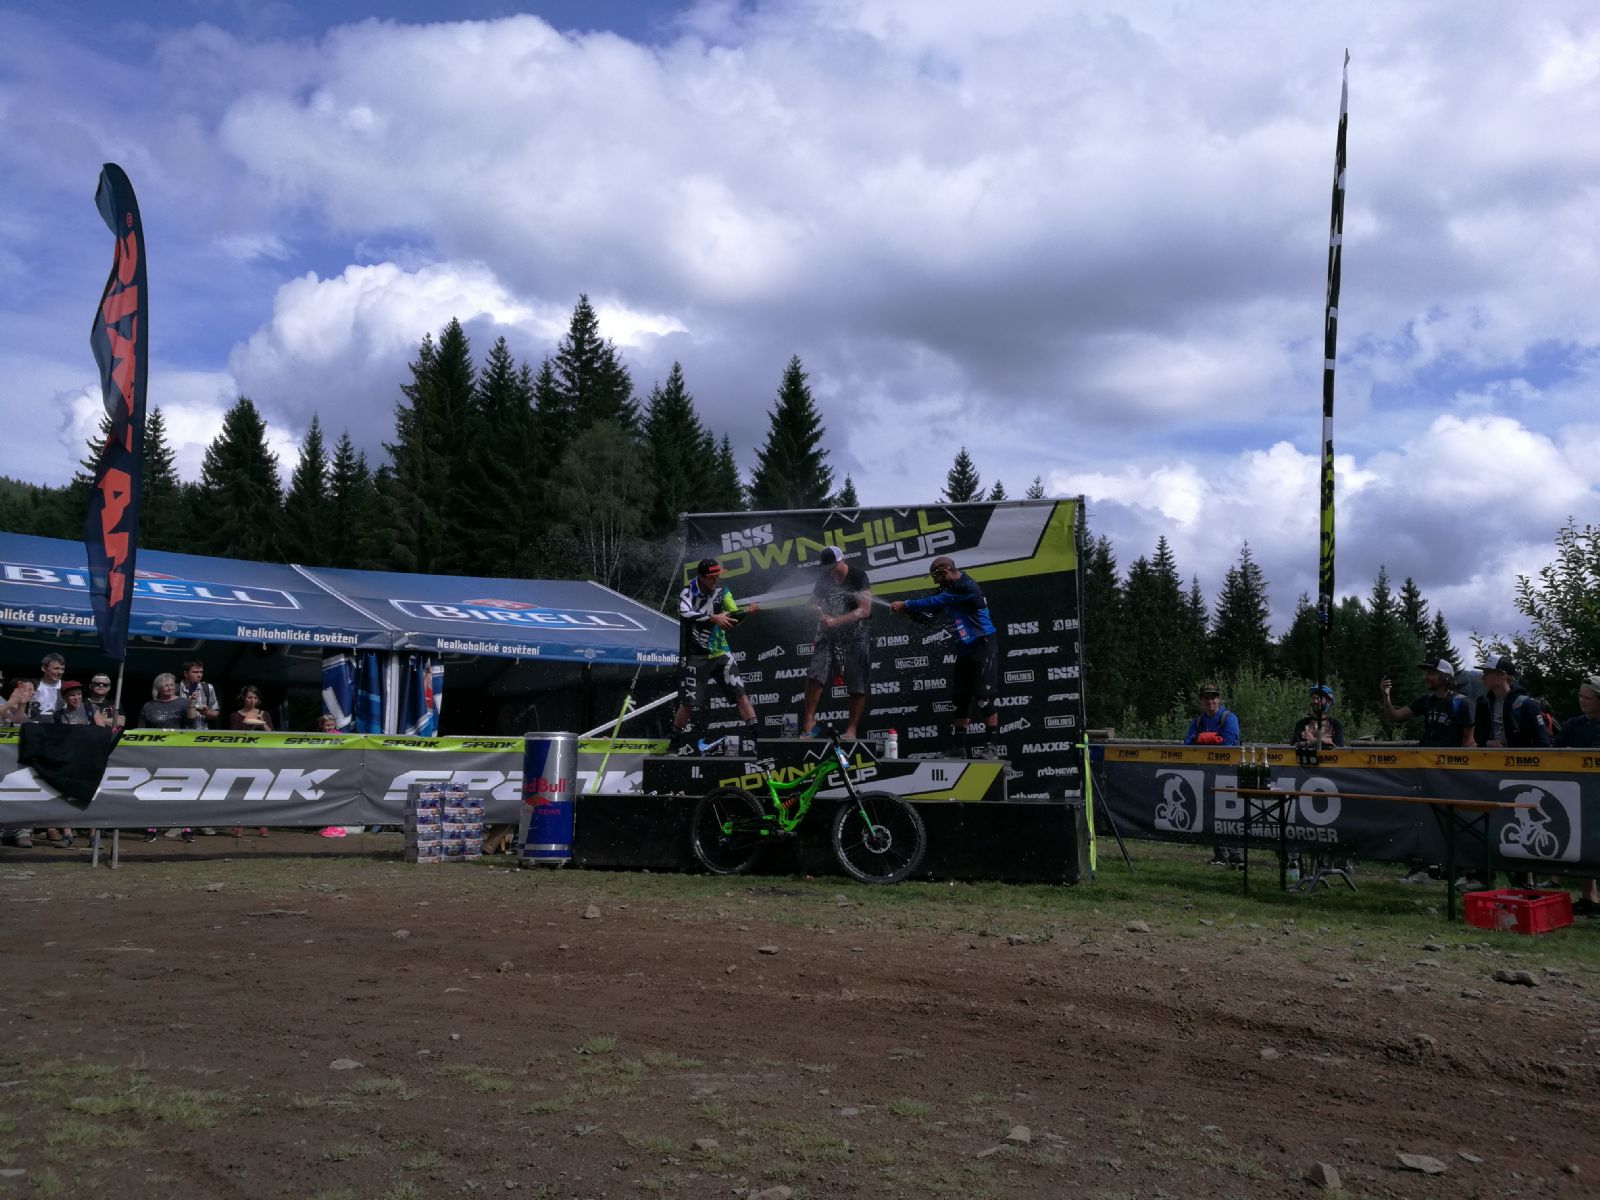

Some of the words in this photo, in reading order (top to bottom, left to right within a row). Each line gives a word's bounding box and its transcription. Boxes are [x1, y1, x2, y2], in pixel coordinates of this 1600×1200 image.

[866, 529, 956, 567] CUP
[4, 565, 276, 605] BIELL
[39, 612, 96, 626] osvěžení
[420, 602, 626, 628] BIRELL
[237, 626, 310, 641] Nealkoholické
[313, 633, 358, 645] osvěžení
[437, 639, 499, 653] Nealkoholické
[502, 643, 540, 656] osvěžení
[637, 652, 680, 664] Nealkoholic
[775, 667, 807, 680] MAXX
[685, 665, 697, 699] FOX
[993, 695, 1030, 707] AXXIS
[1021, 741, 1070, 754] MAXXIS
[1214, 752, 1231, 760] BMO
[1377, 755, 1397, 763] BMO
[1447, 755, 1469, 764] BMO
[1516, 756, 1540, 765] BMO
